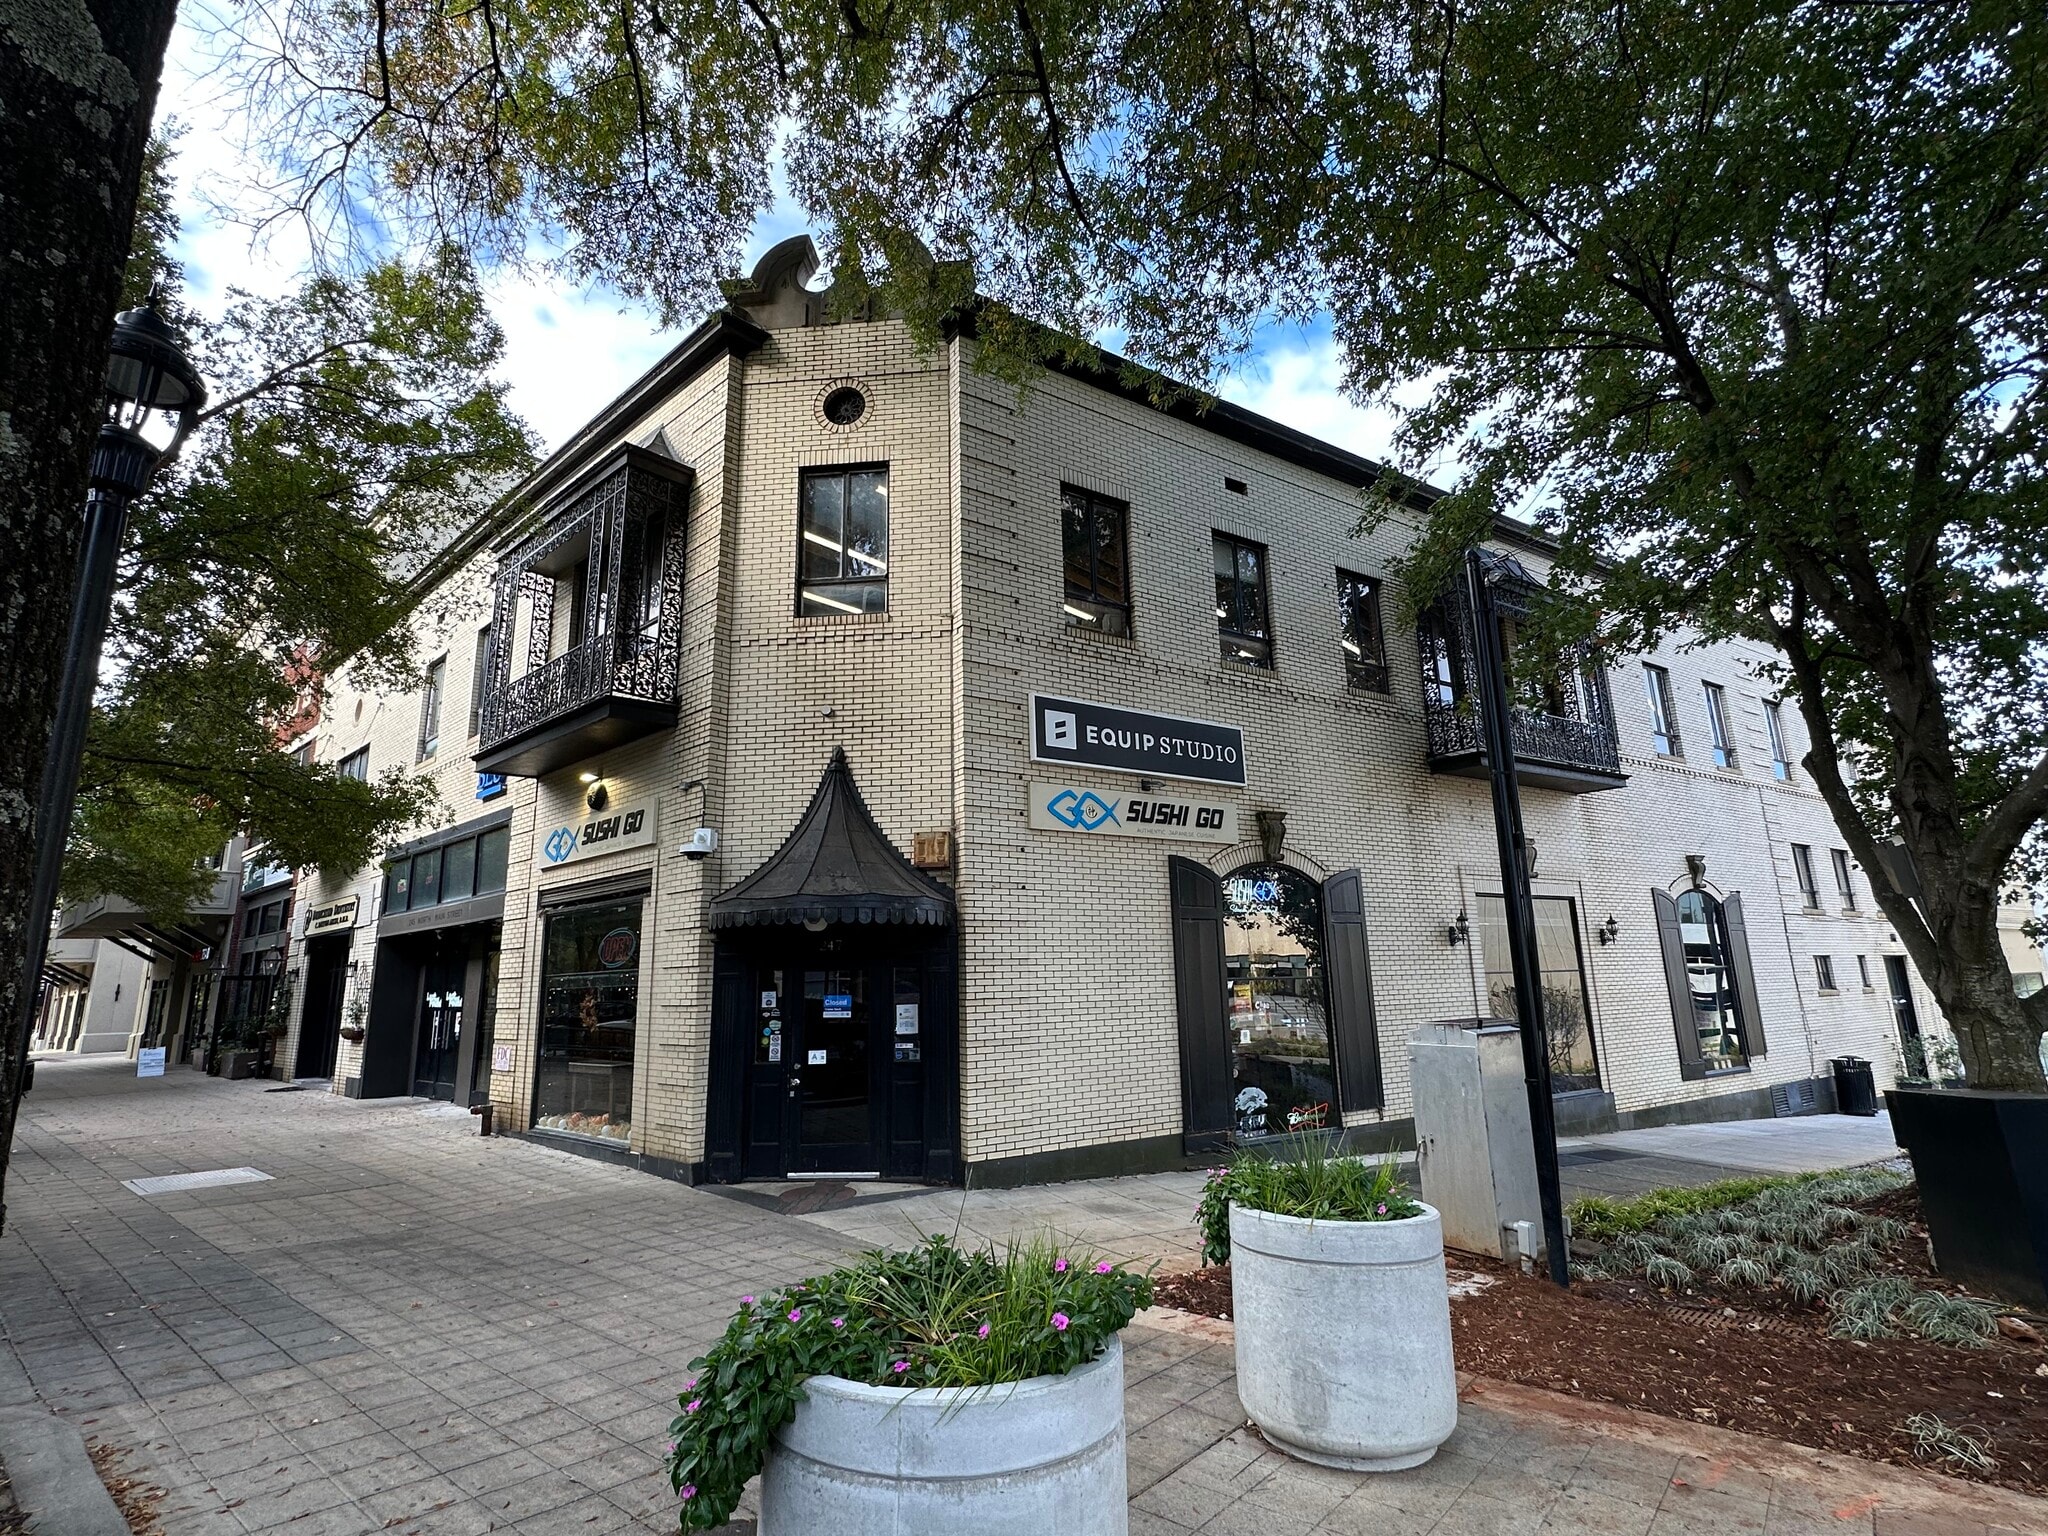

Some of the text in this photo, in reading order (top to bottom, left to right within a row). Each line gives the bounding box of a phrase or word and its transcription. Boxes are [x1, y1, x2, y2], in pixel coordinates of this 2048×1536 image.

[1086, 725, 1237, 764] EQUIP STUDIO
[1126, 800, 1225, 830] SUSHI GO
[581, 809, 645, 846] SUSHI GO
[1137, 828, 1166, 836] AUTHENTIC
[1168, 829, 1195, 838] JAPANESE
[447, 908, 463, 919] STREET
[824, 999, 848, 1007] Closed
